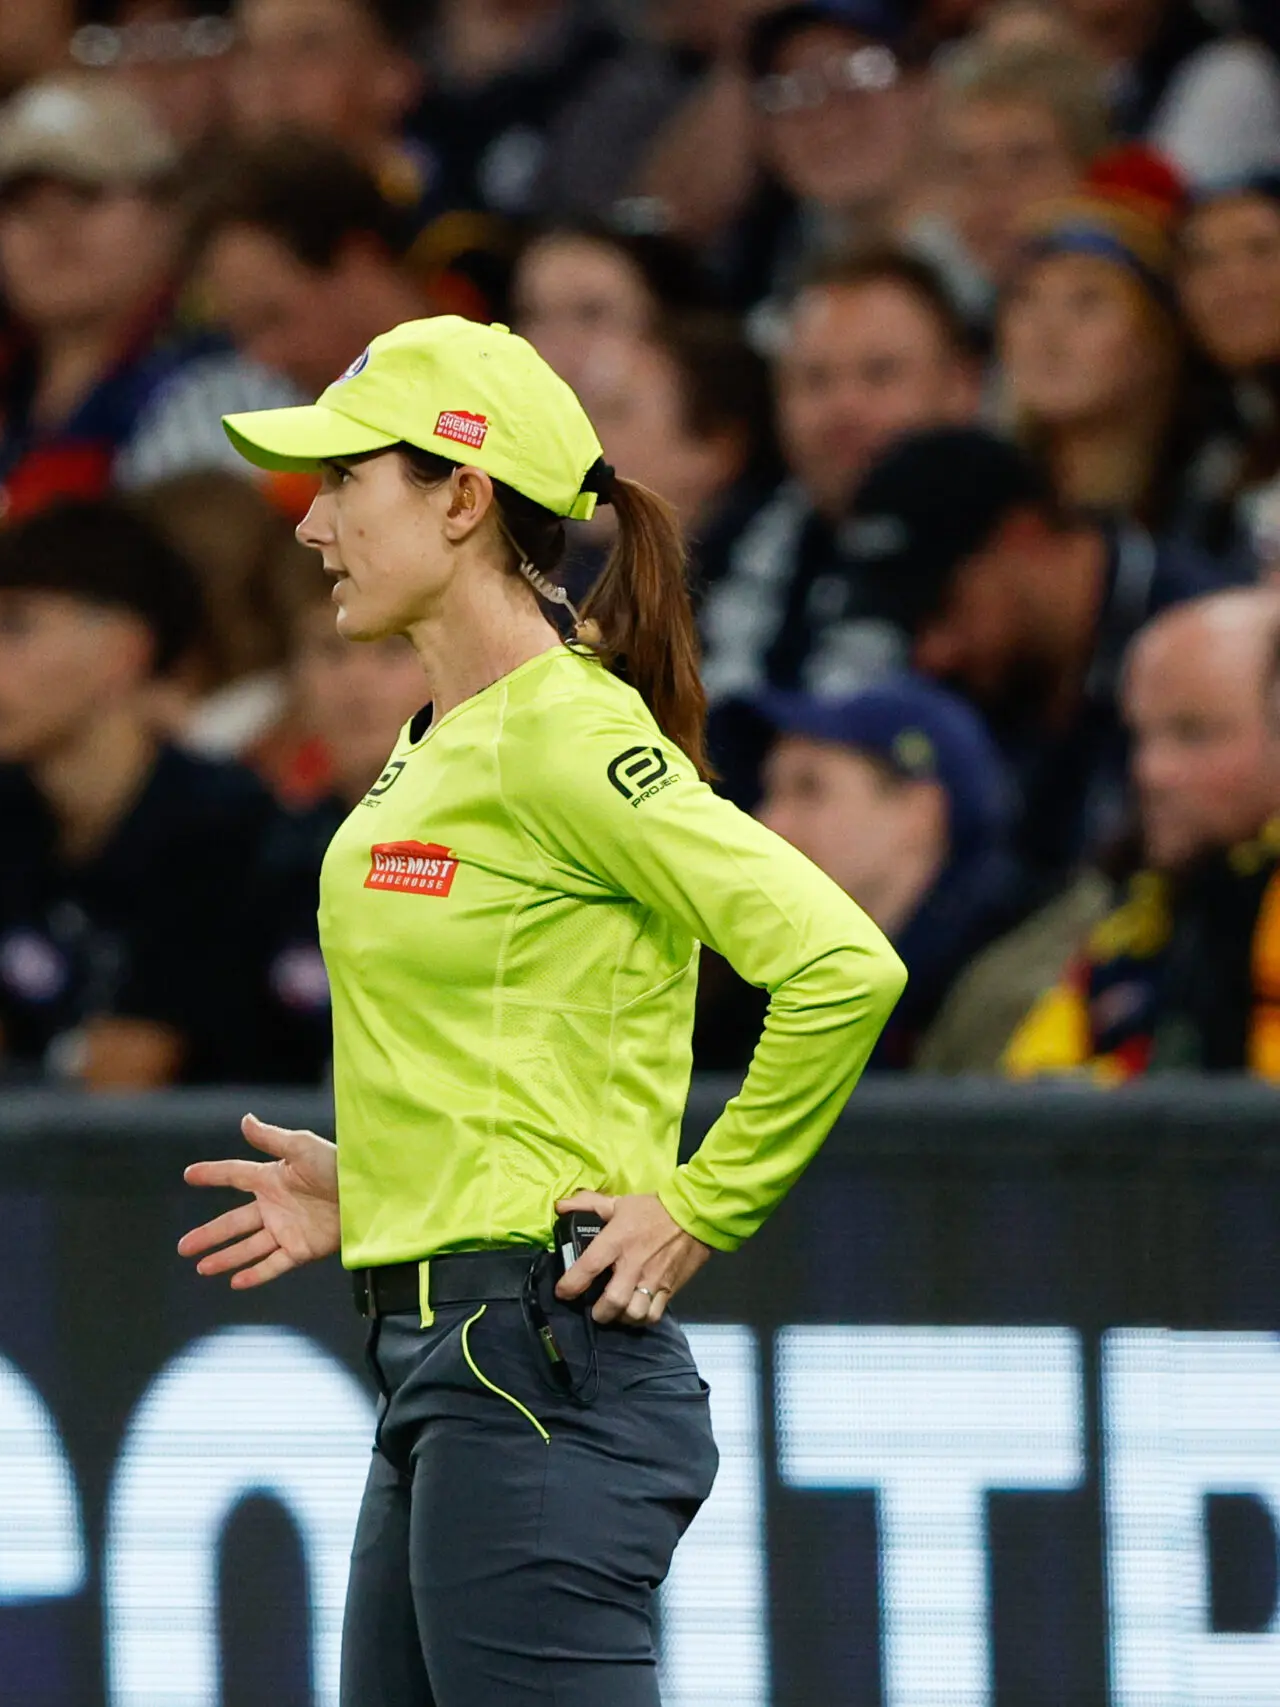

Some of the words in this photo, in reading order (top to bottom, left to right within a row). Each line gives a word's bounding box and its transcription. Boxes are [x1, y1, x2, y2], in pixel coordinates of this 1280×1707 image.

[439, 415, 487, 439] CHEMIST
[631, 773, 682, 809] PROJECT
[375, 853, 454, 878] CHEMIST
[370, 873, 444, 890] WAREHOUSE
